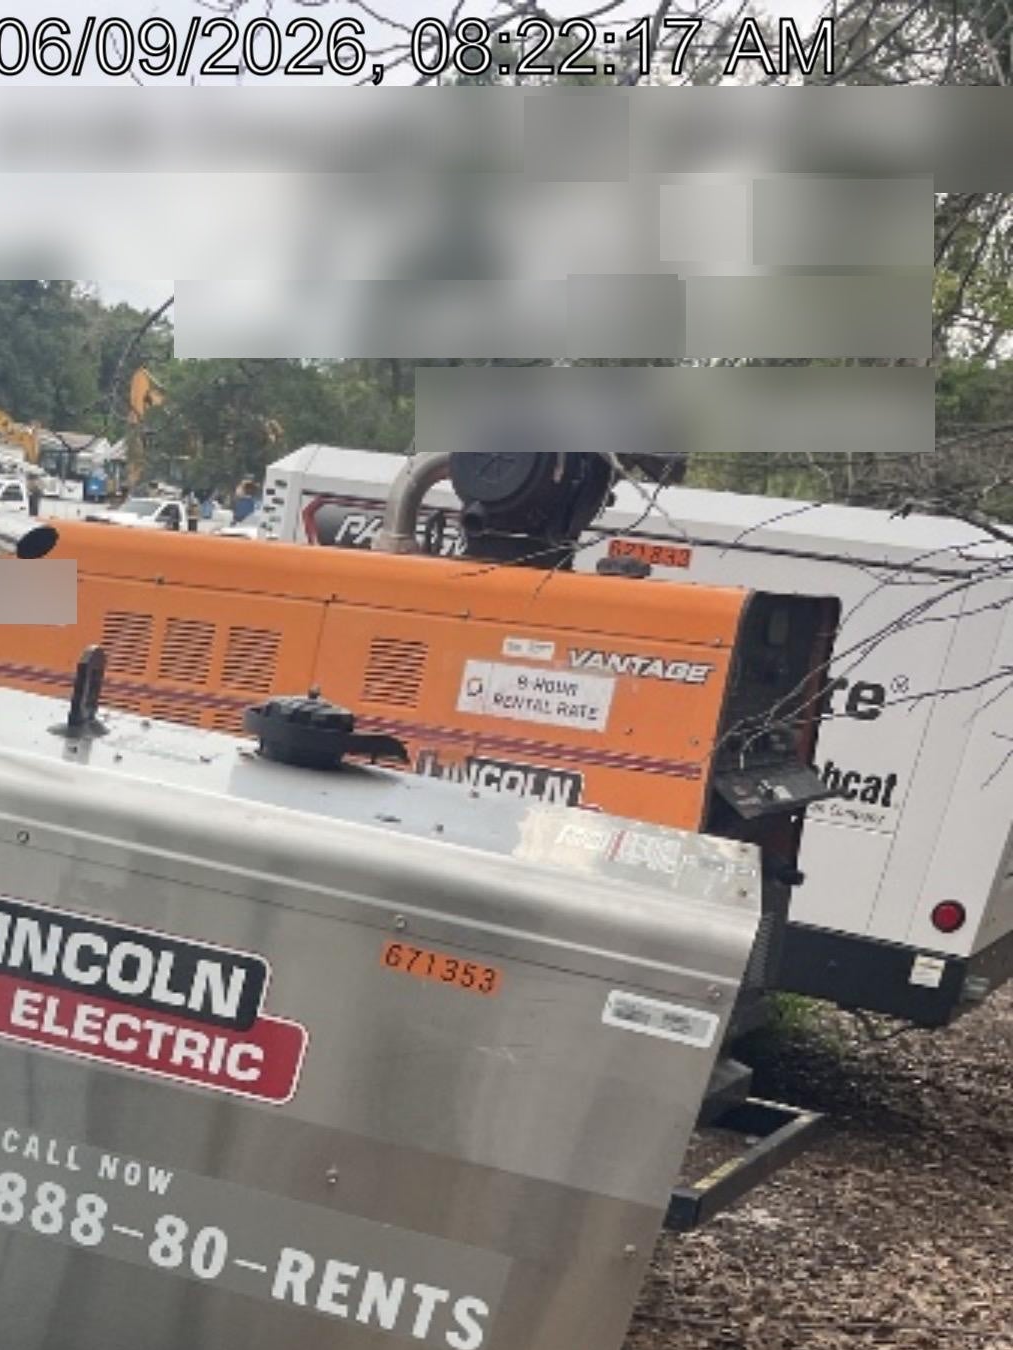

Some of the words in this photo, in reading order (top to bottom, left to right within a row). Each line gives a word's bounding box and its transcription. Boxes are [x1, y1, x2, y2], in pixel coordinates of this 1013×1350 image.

[569, 650, 715, 684] VANTAGE
[493, 692, 553, 714] RENTAL
[556, 702, 599, 721] RATE
[385, 944, 495, 994] 671353
[10, 989, 265, 1082] ELECTRIC
[1, 1128, 82, 1171] CALL
[98, 1154, 175, 1196] NOW
